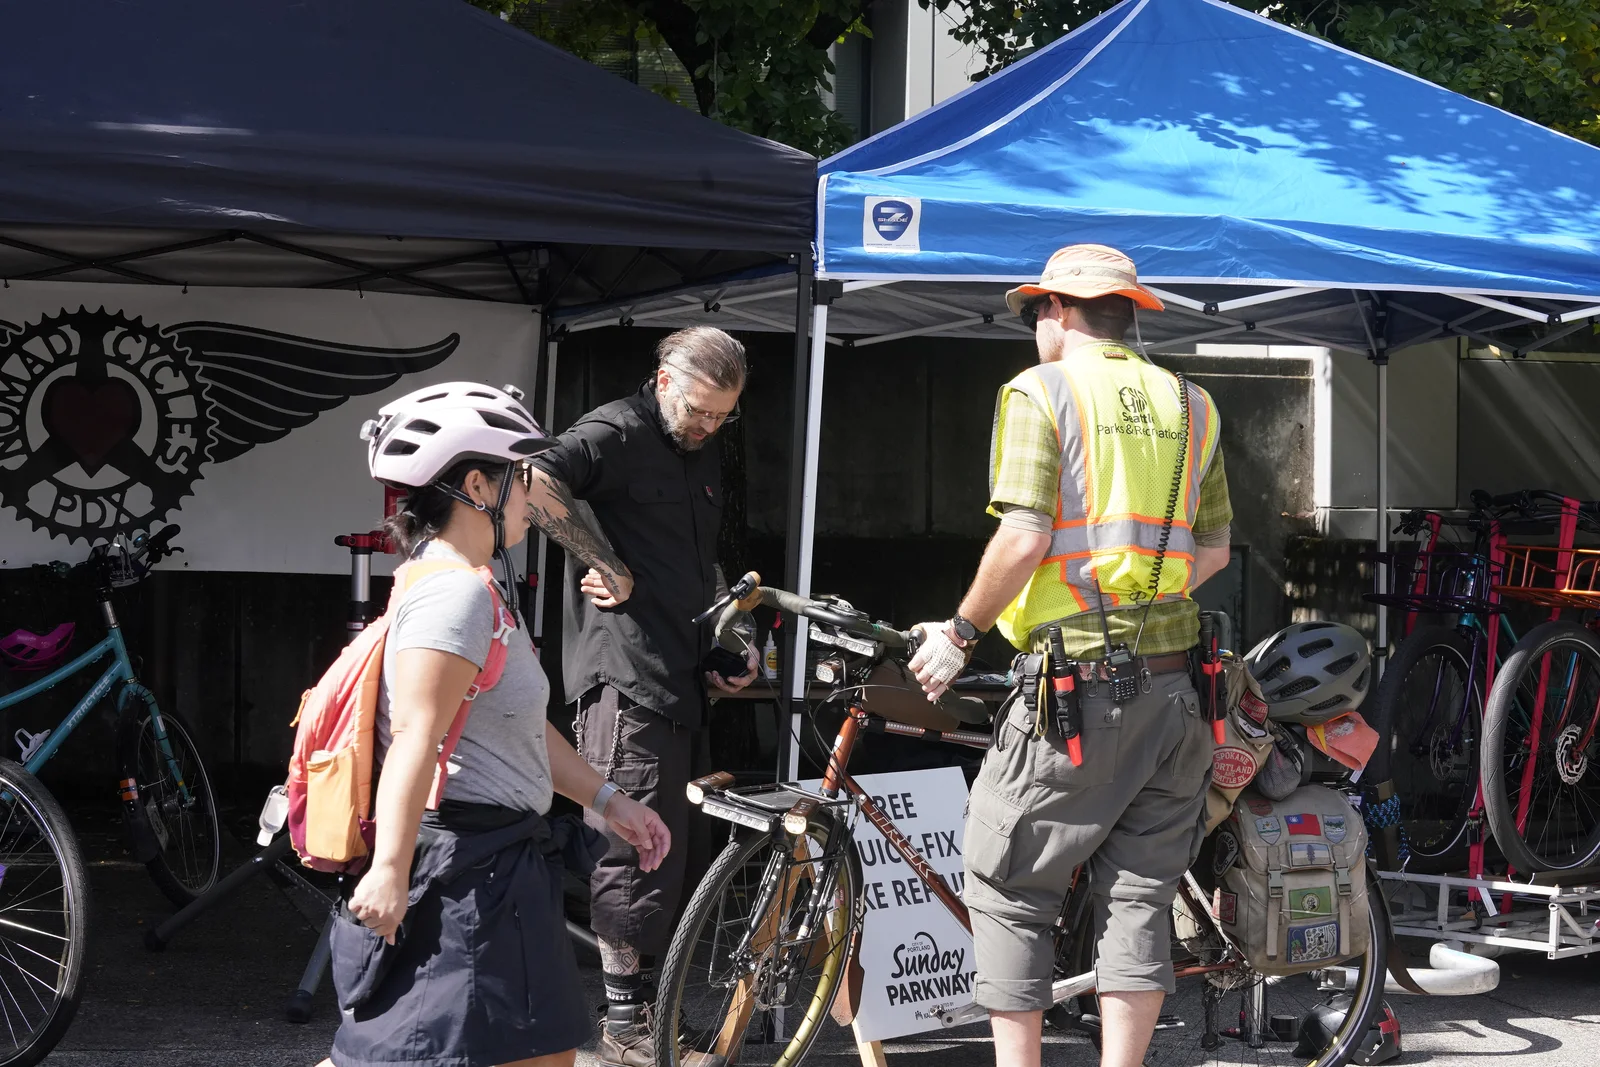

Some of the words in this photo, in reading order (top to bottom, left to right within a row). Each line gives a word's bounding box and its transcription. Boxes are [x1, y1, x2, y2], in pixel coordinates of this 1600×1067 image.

[112, 328, 198, 476] CYCLES
[1097, 423, 1125, 435] Parks
[1126, 424, 1134, 435] &
[50, 491, 137, 527] PDX
[66, 675, 110, 728] XTRACYCLE
[1214, 762, 1252, 775] ORTLAND
[1215, 752, 1250, 766] SPOKANE
[863, 792, 918, 823] REE
[857, 830, 962, 867] UIC-FIX
[871, 803, 938, 879] TREK
[891, 931, 965, 979] Sunday
[907, 944, 931, 953] PORTLAND
